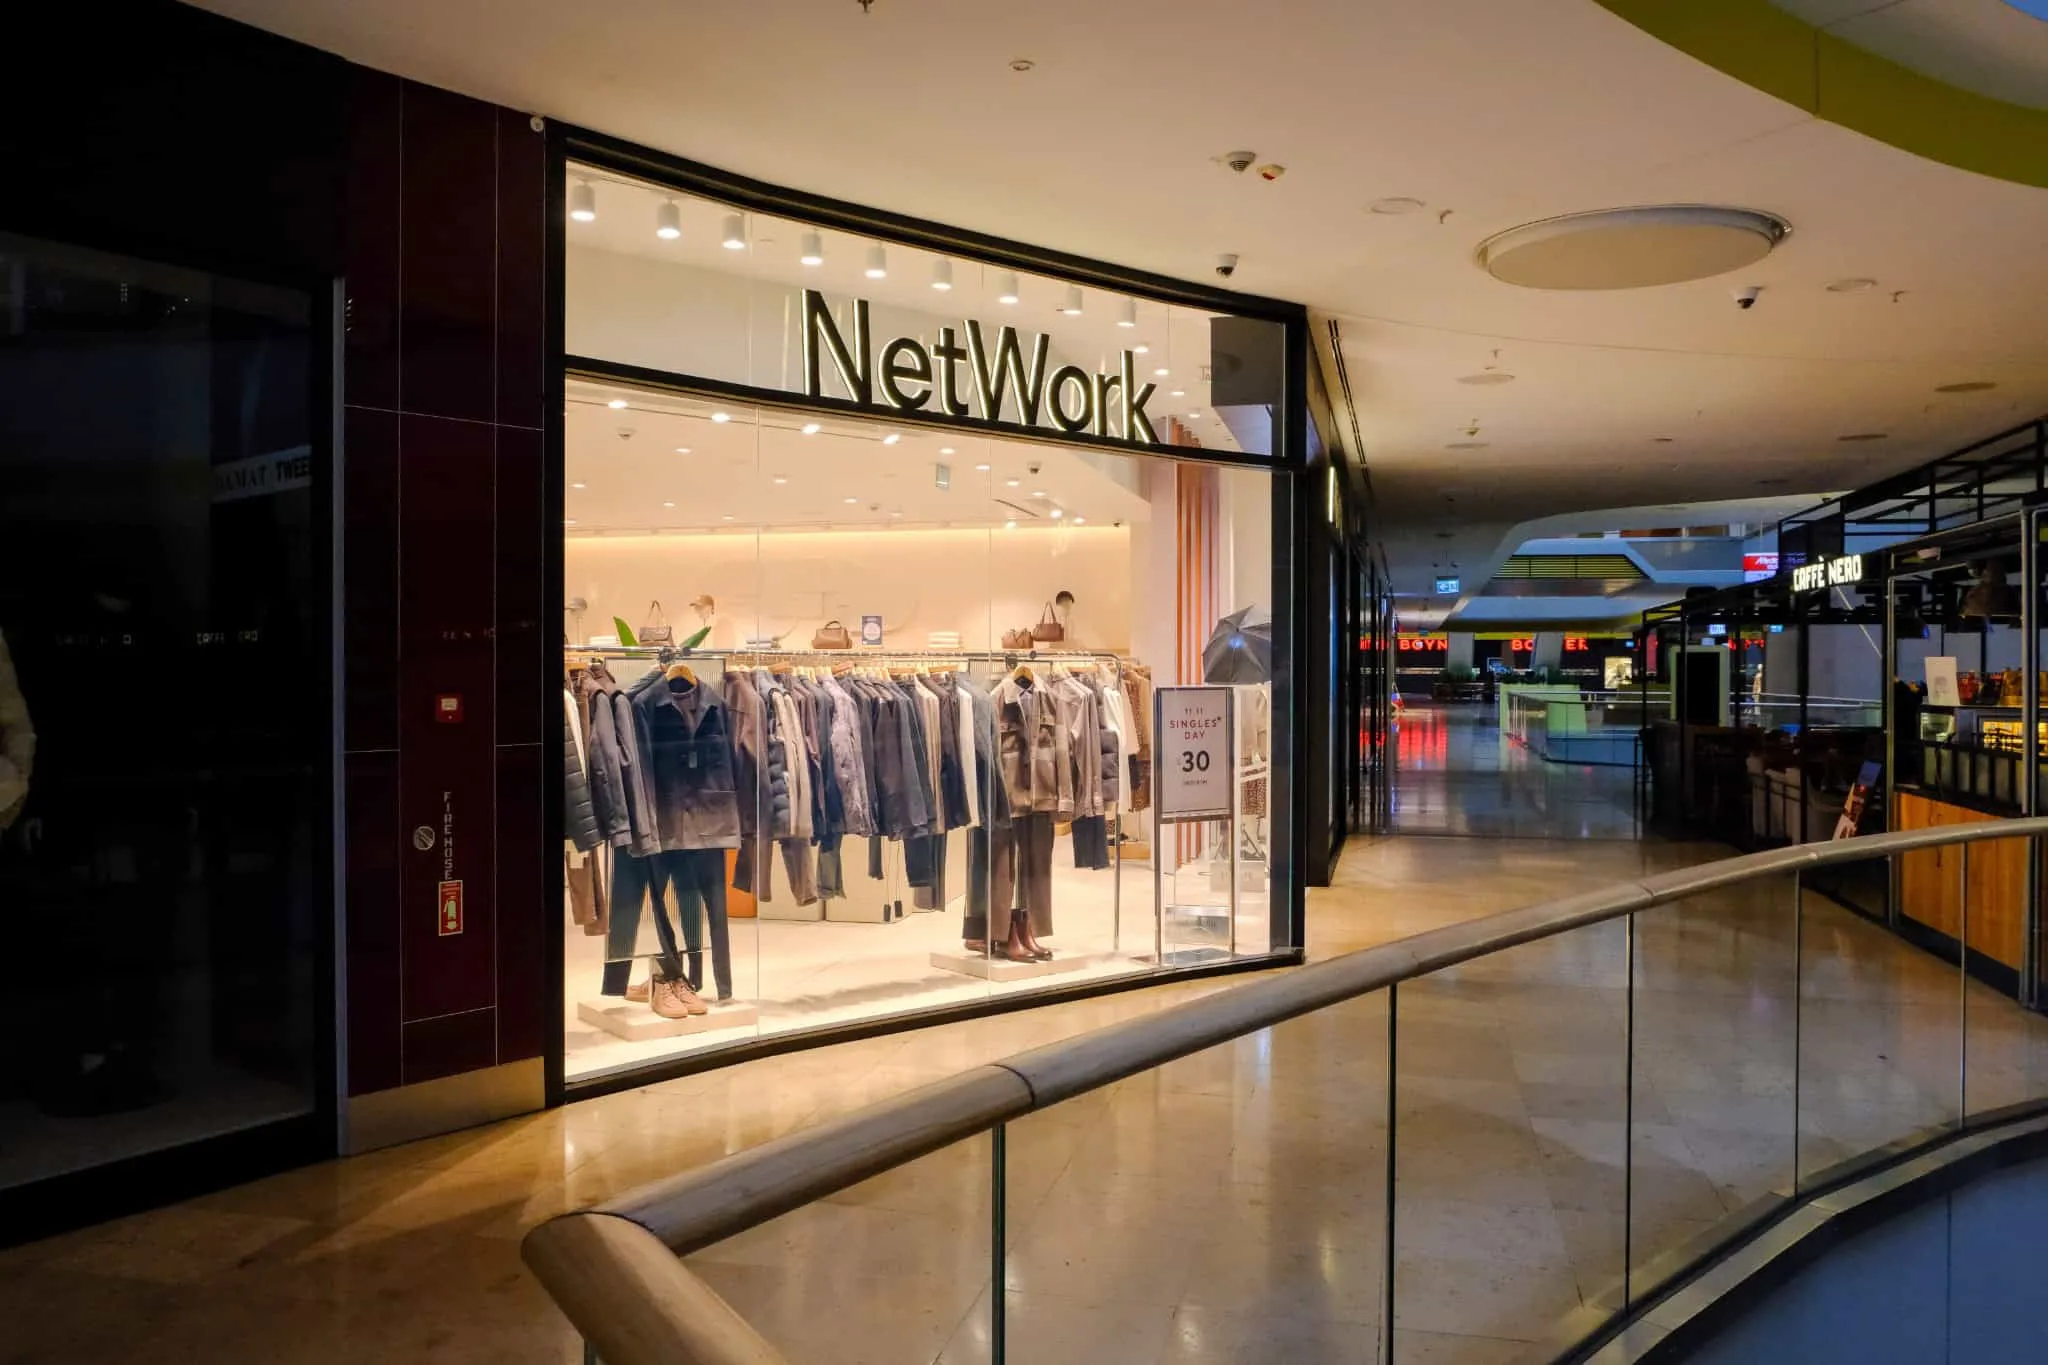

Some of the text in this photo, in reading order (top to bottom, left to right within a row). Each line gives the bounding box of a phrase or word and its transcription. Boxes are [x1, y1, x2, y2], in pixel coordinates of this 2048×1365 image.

[801, 287, 1161, 444] NetWork
[276, 457, 310, 482] TWEE
[1827, 554, 1862, 585] NERO
[1399, 639, 1448, 651] BOYN
[1184, 731, 1205, 740] DAY
[1182, 750, 1210, 773] 30
